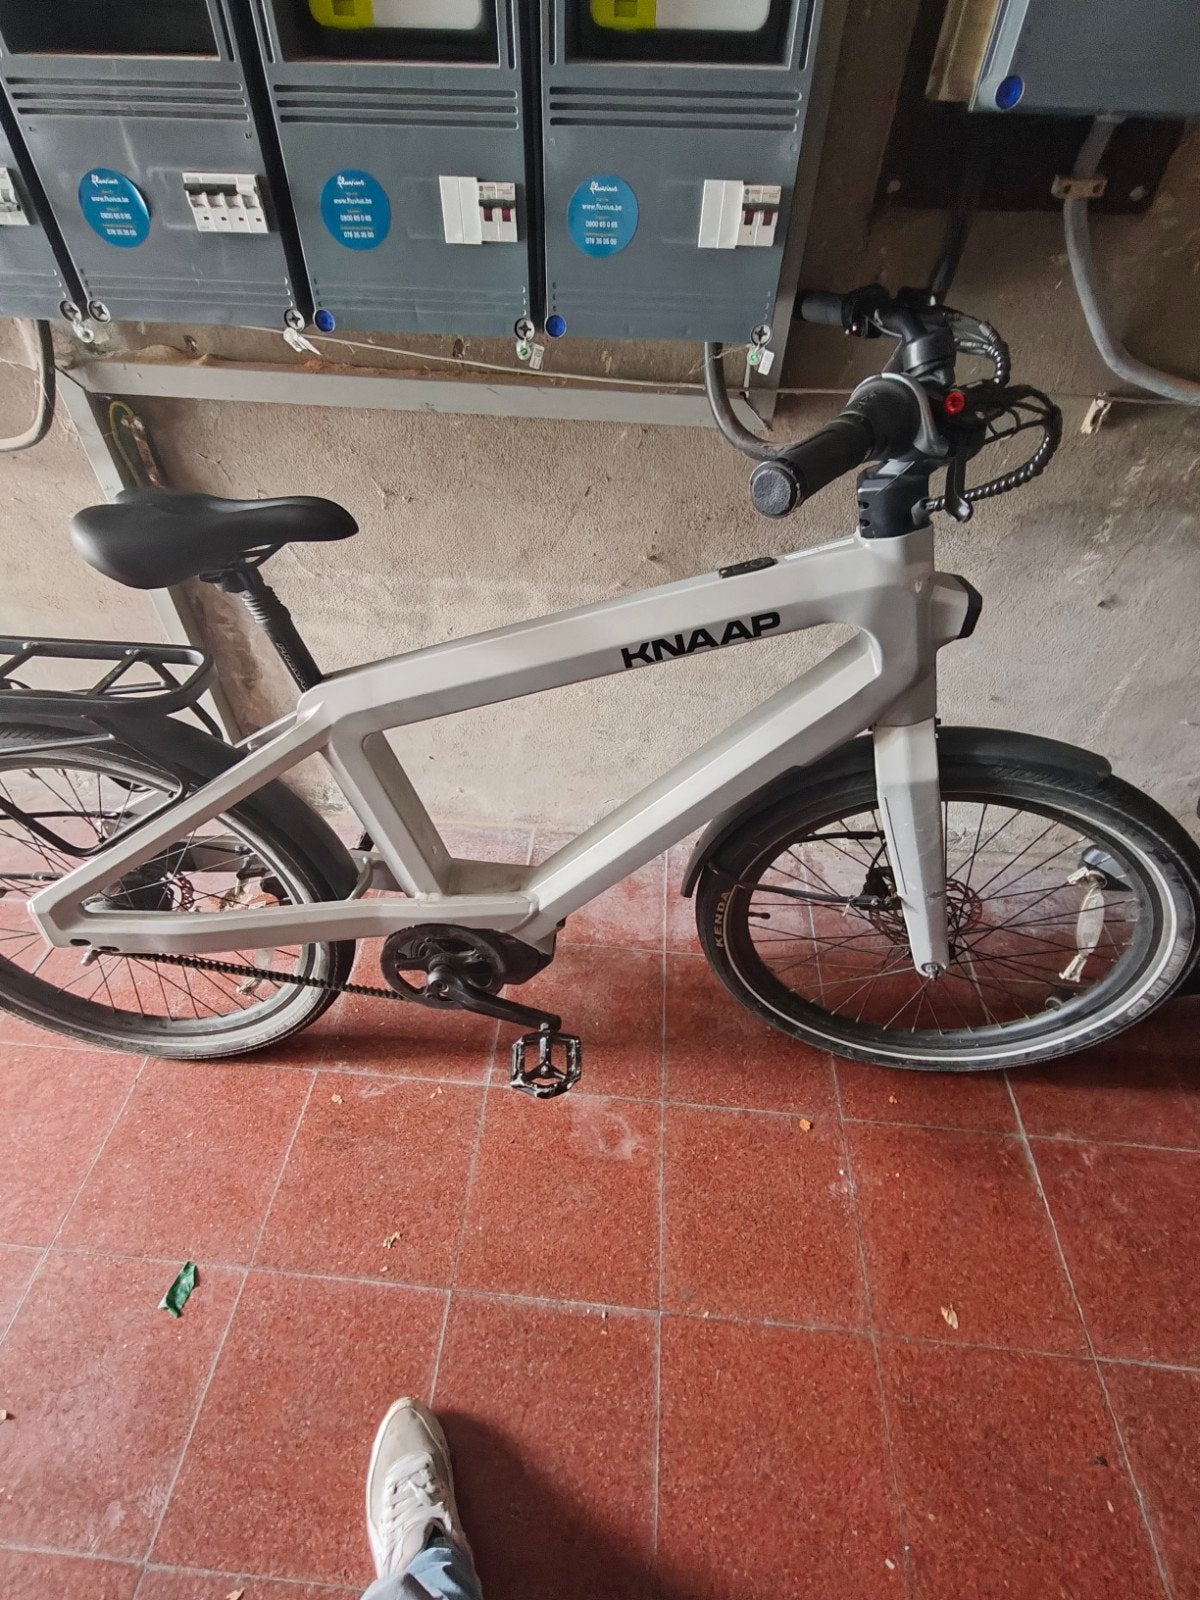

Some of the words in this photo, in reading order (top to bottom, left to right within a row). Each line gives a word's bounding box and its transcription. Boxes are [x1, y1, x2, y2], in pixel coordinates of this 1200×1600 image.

[590, 180, 618, 194] fluvius
[620, 611, 781, 669] KNAAP
[713, 892, 731, 948] KENDA
